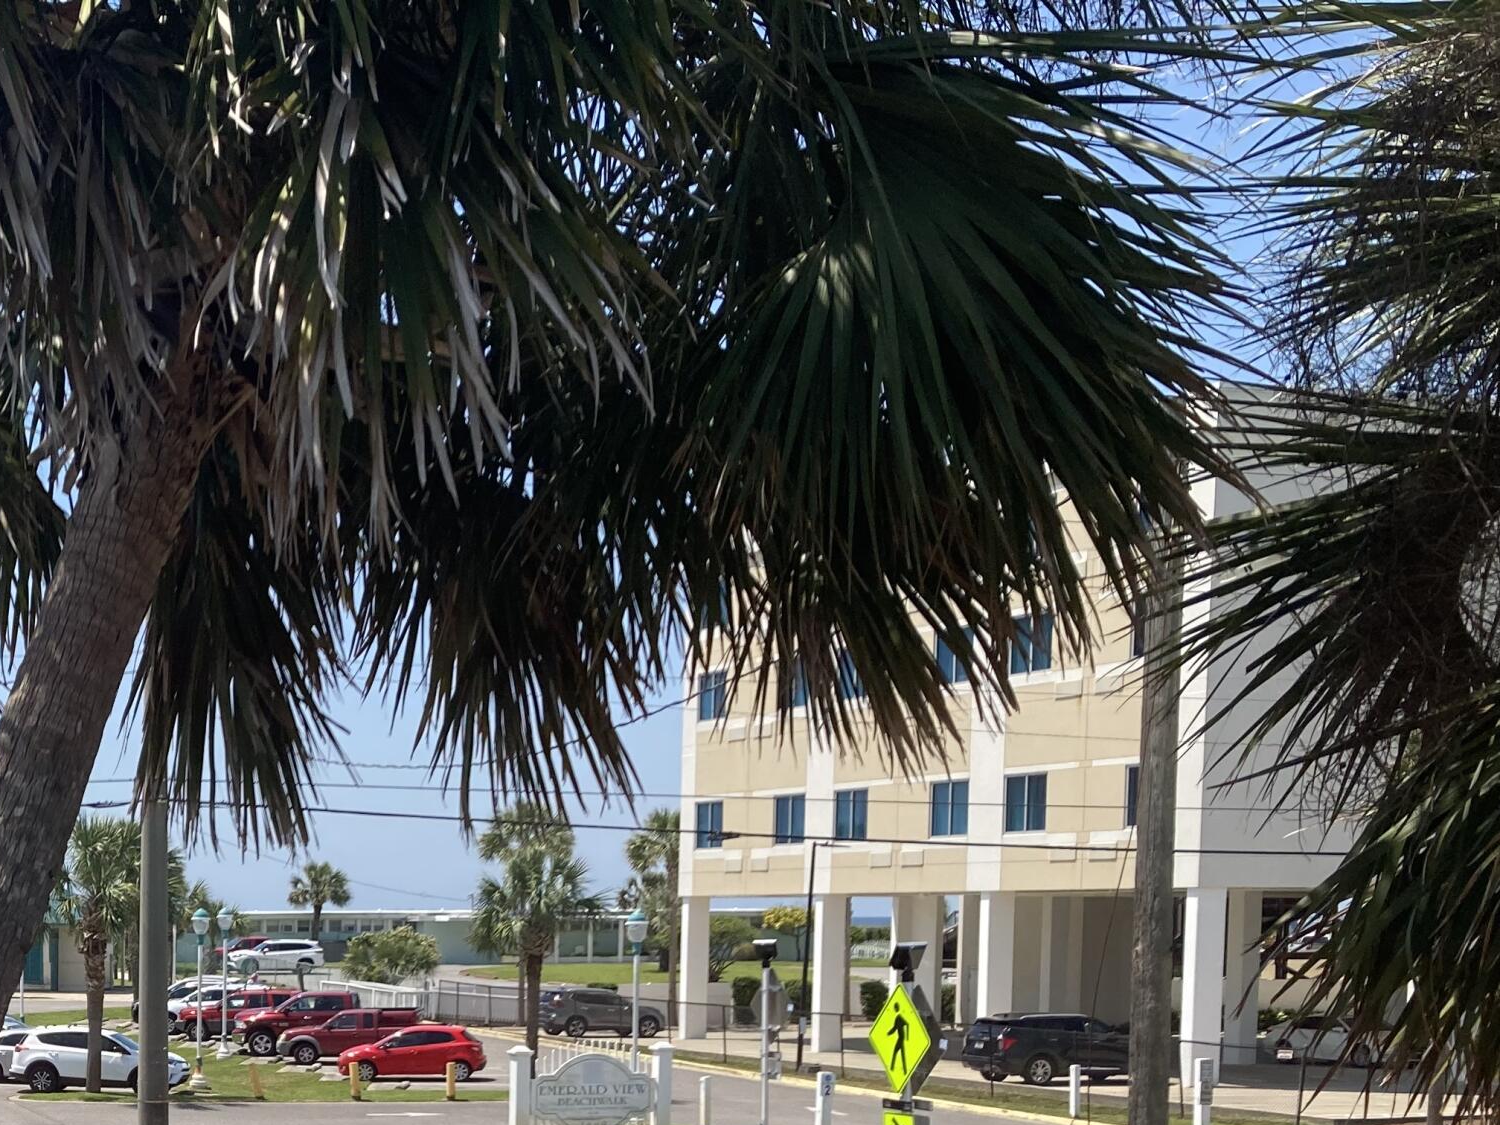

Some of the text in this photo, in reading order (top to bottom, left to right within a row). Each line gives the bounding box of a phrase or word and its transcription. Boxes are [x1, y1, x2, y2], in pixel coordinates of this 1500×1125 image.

[539, 1084, 646, 1096] EMERALD VIEW
[824, 1084, 832, 1097] 2
[557, 1097, 627, 1106] BEACHWALK
